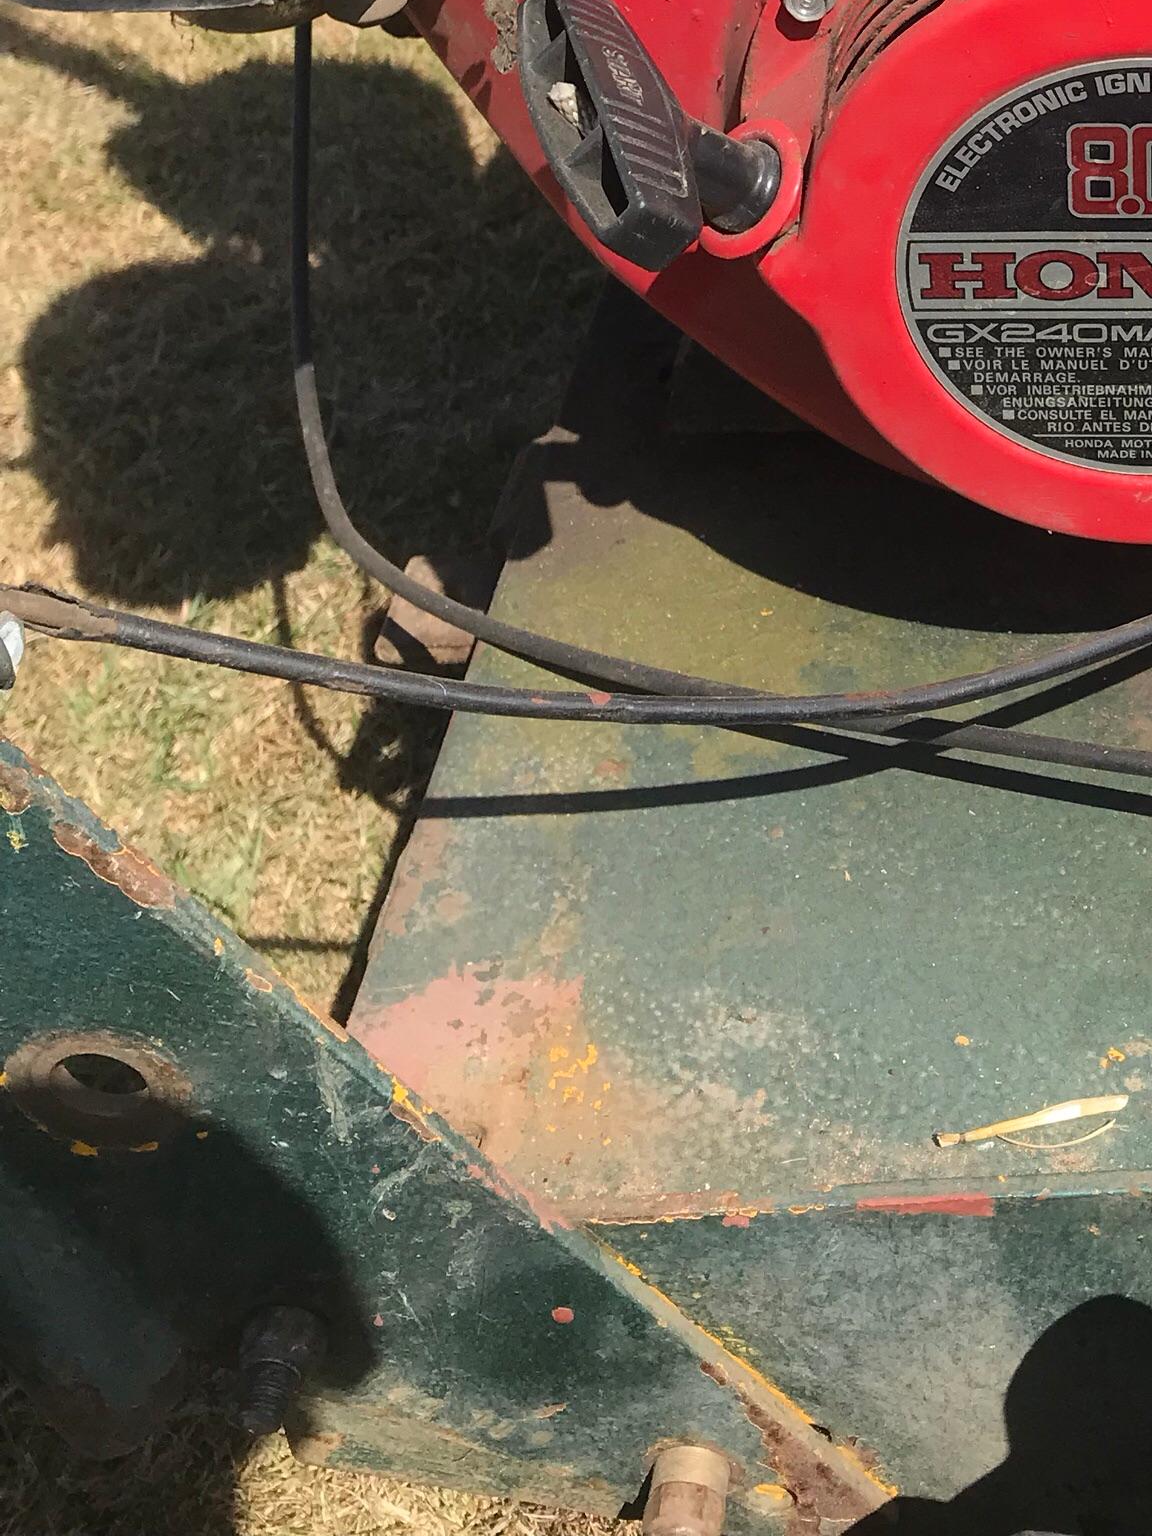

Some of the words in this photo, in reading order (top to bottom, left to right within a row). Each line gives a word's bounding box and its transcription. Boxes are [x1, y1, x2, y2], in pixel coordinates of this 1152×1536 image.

[602, 46, 644, 107] START
[935, 80, 1089, 194] ELECTRONIC
[955, 347, 984, 358] SEE
[994, 347, 1025, 358] THE
[1036, 347, 1112, 358] OWNER'S
[963, 359, 1002, 370] VOIR
[1012, 359, 1029, 370] LE
[1040, 359, 1107, 370] MANUEL
[974, 372, 1081, 383] DEMARRAGE.
[986, 385, 1017, 396] VOR
[1017, 410, 1092, 420] CONSULTE
[1101, 410, 1116, 420] EL
[1047, 422, 1075, 433] RIO
[1081, 422, 1131, 433] ANTES
[1065, 439, 1113, 448] HONDA
[1097, 450, 1136, 459] MADE
